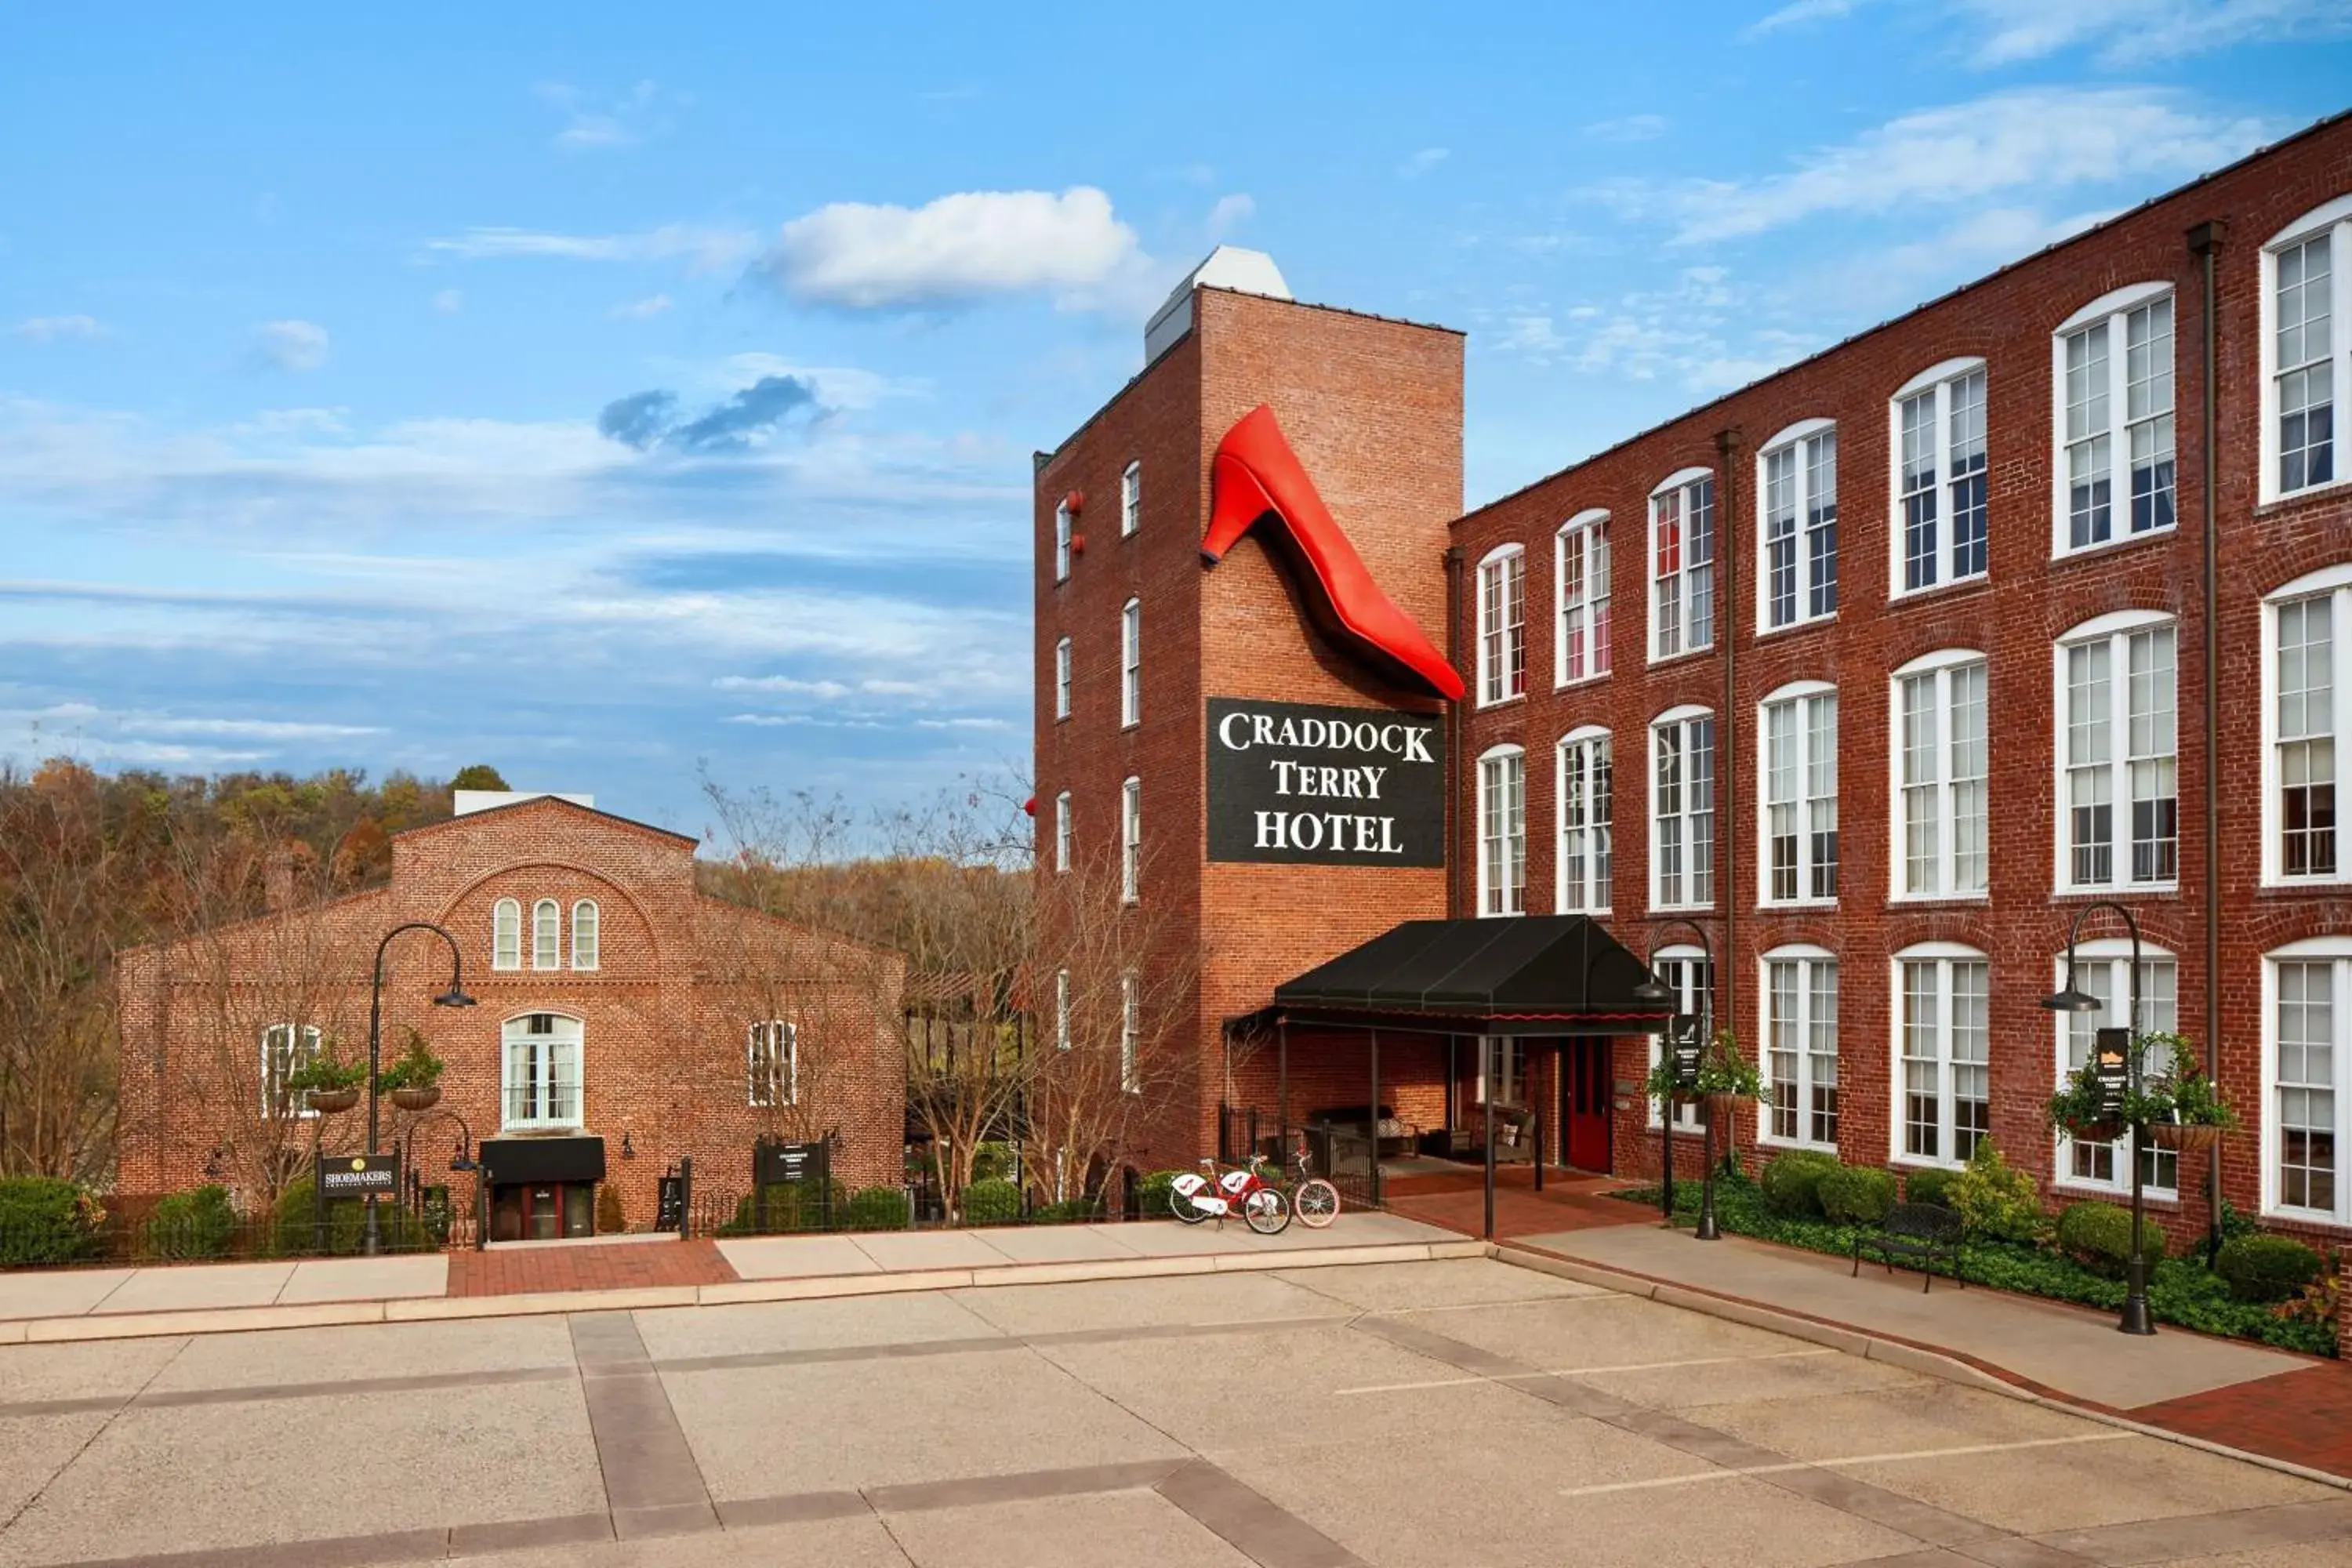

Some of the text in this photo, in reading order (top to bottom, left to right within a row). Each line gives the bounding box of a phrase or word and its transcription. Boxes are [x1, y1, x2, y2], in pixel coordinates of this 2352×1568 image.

[1219, 712, 1435, 763] CRADDOCK
[1269, 760, 1387, 799] TERRY
[1254, 811, 1403, 853] HOTEL
[325, 1171, 392, 1185] SHOEMAKERS
